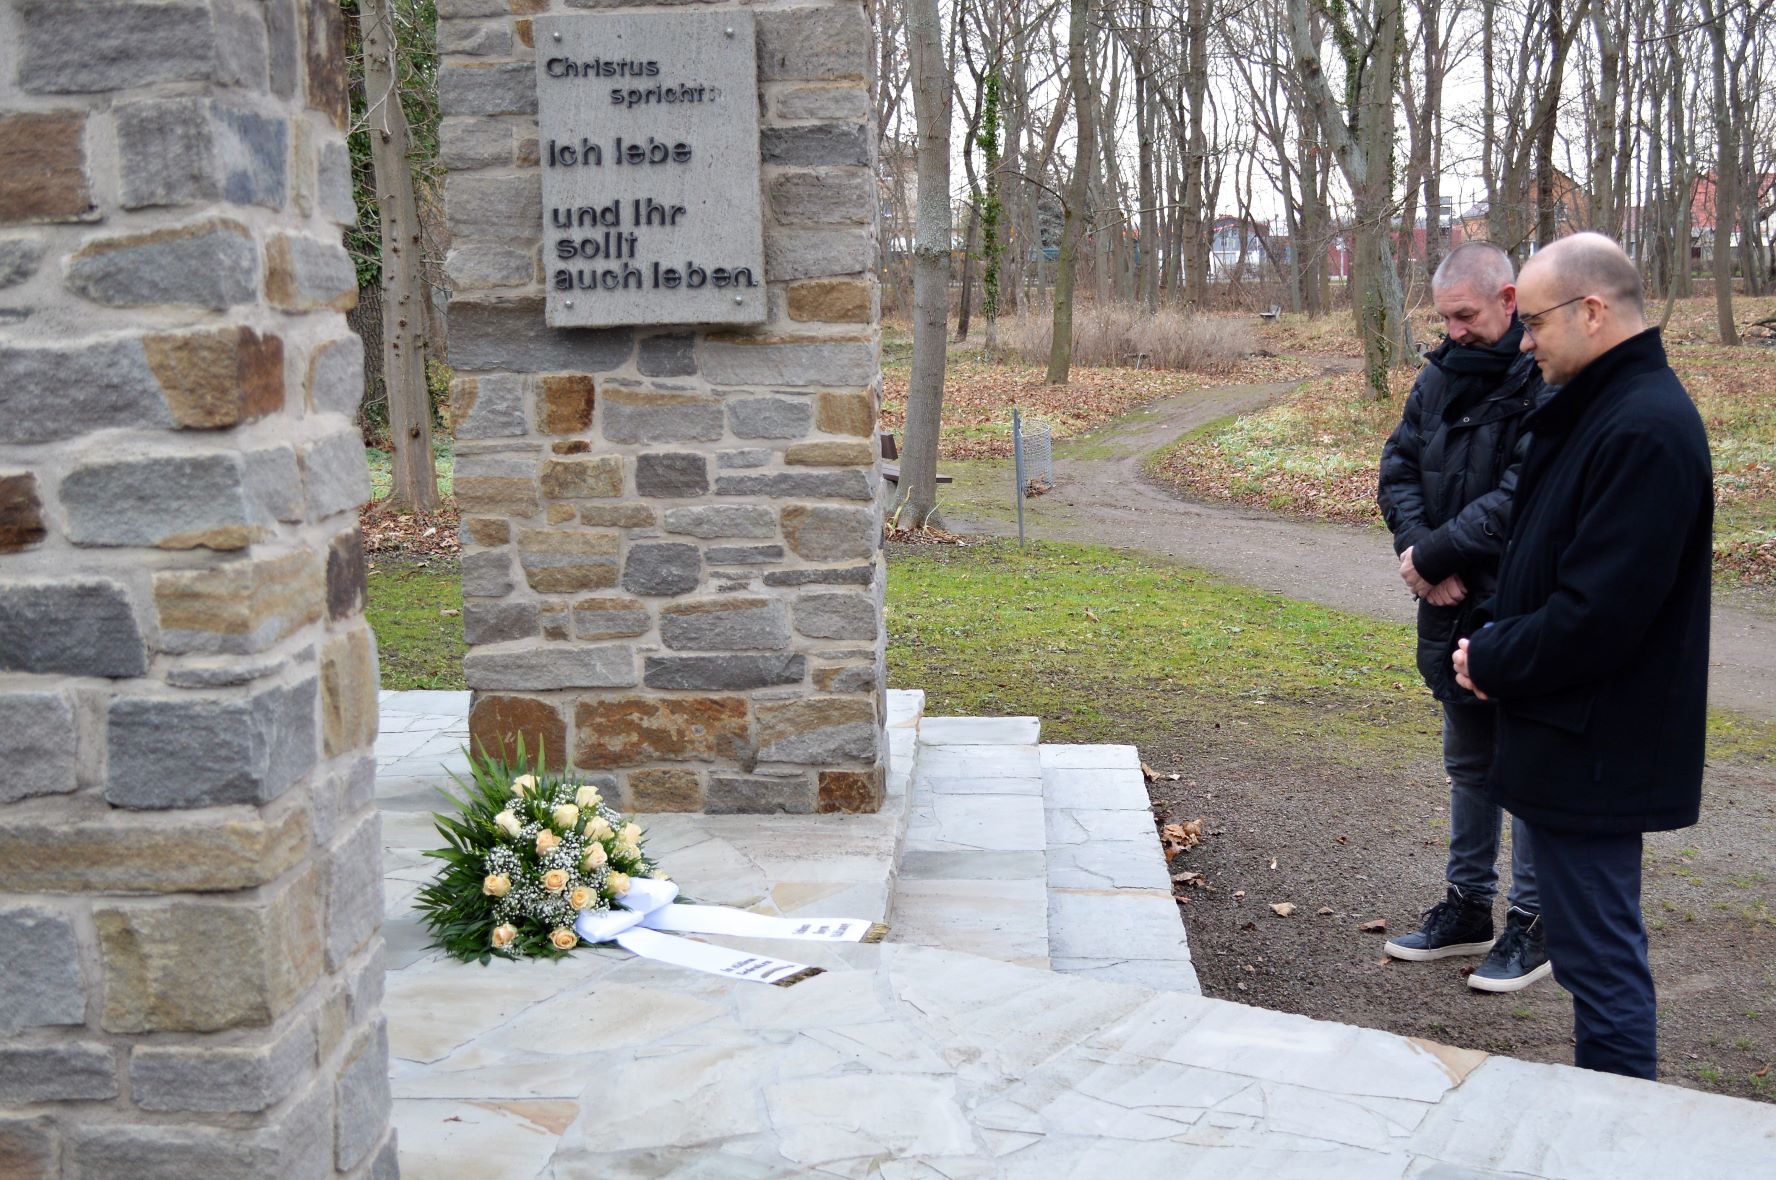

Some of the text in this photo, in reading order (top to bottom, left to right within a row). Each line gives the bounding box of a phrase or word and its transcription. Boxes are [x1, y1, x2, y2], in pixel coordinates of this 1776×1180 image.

[546, 57, 660, 78] Christus
[547, 136, 692, 167] Ich lebe
[553, 197, 687, 229] und Ihr
[555, 231, 638, 259] sollt
[554, 262, 643, 290] auch
